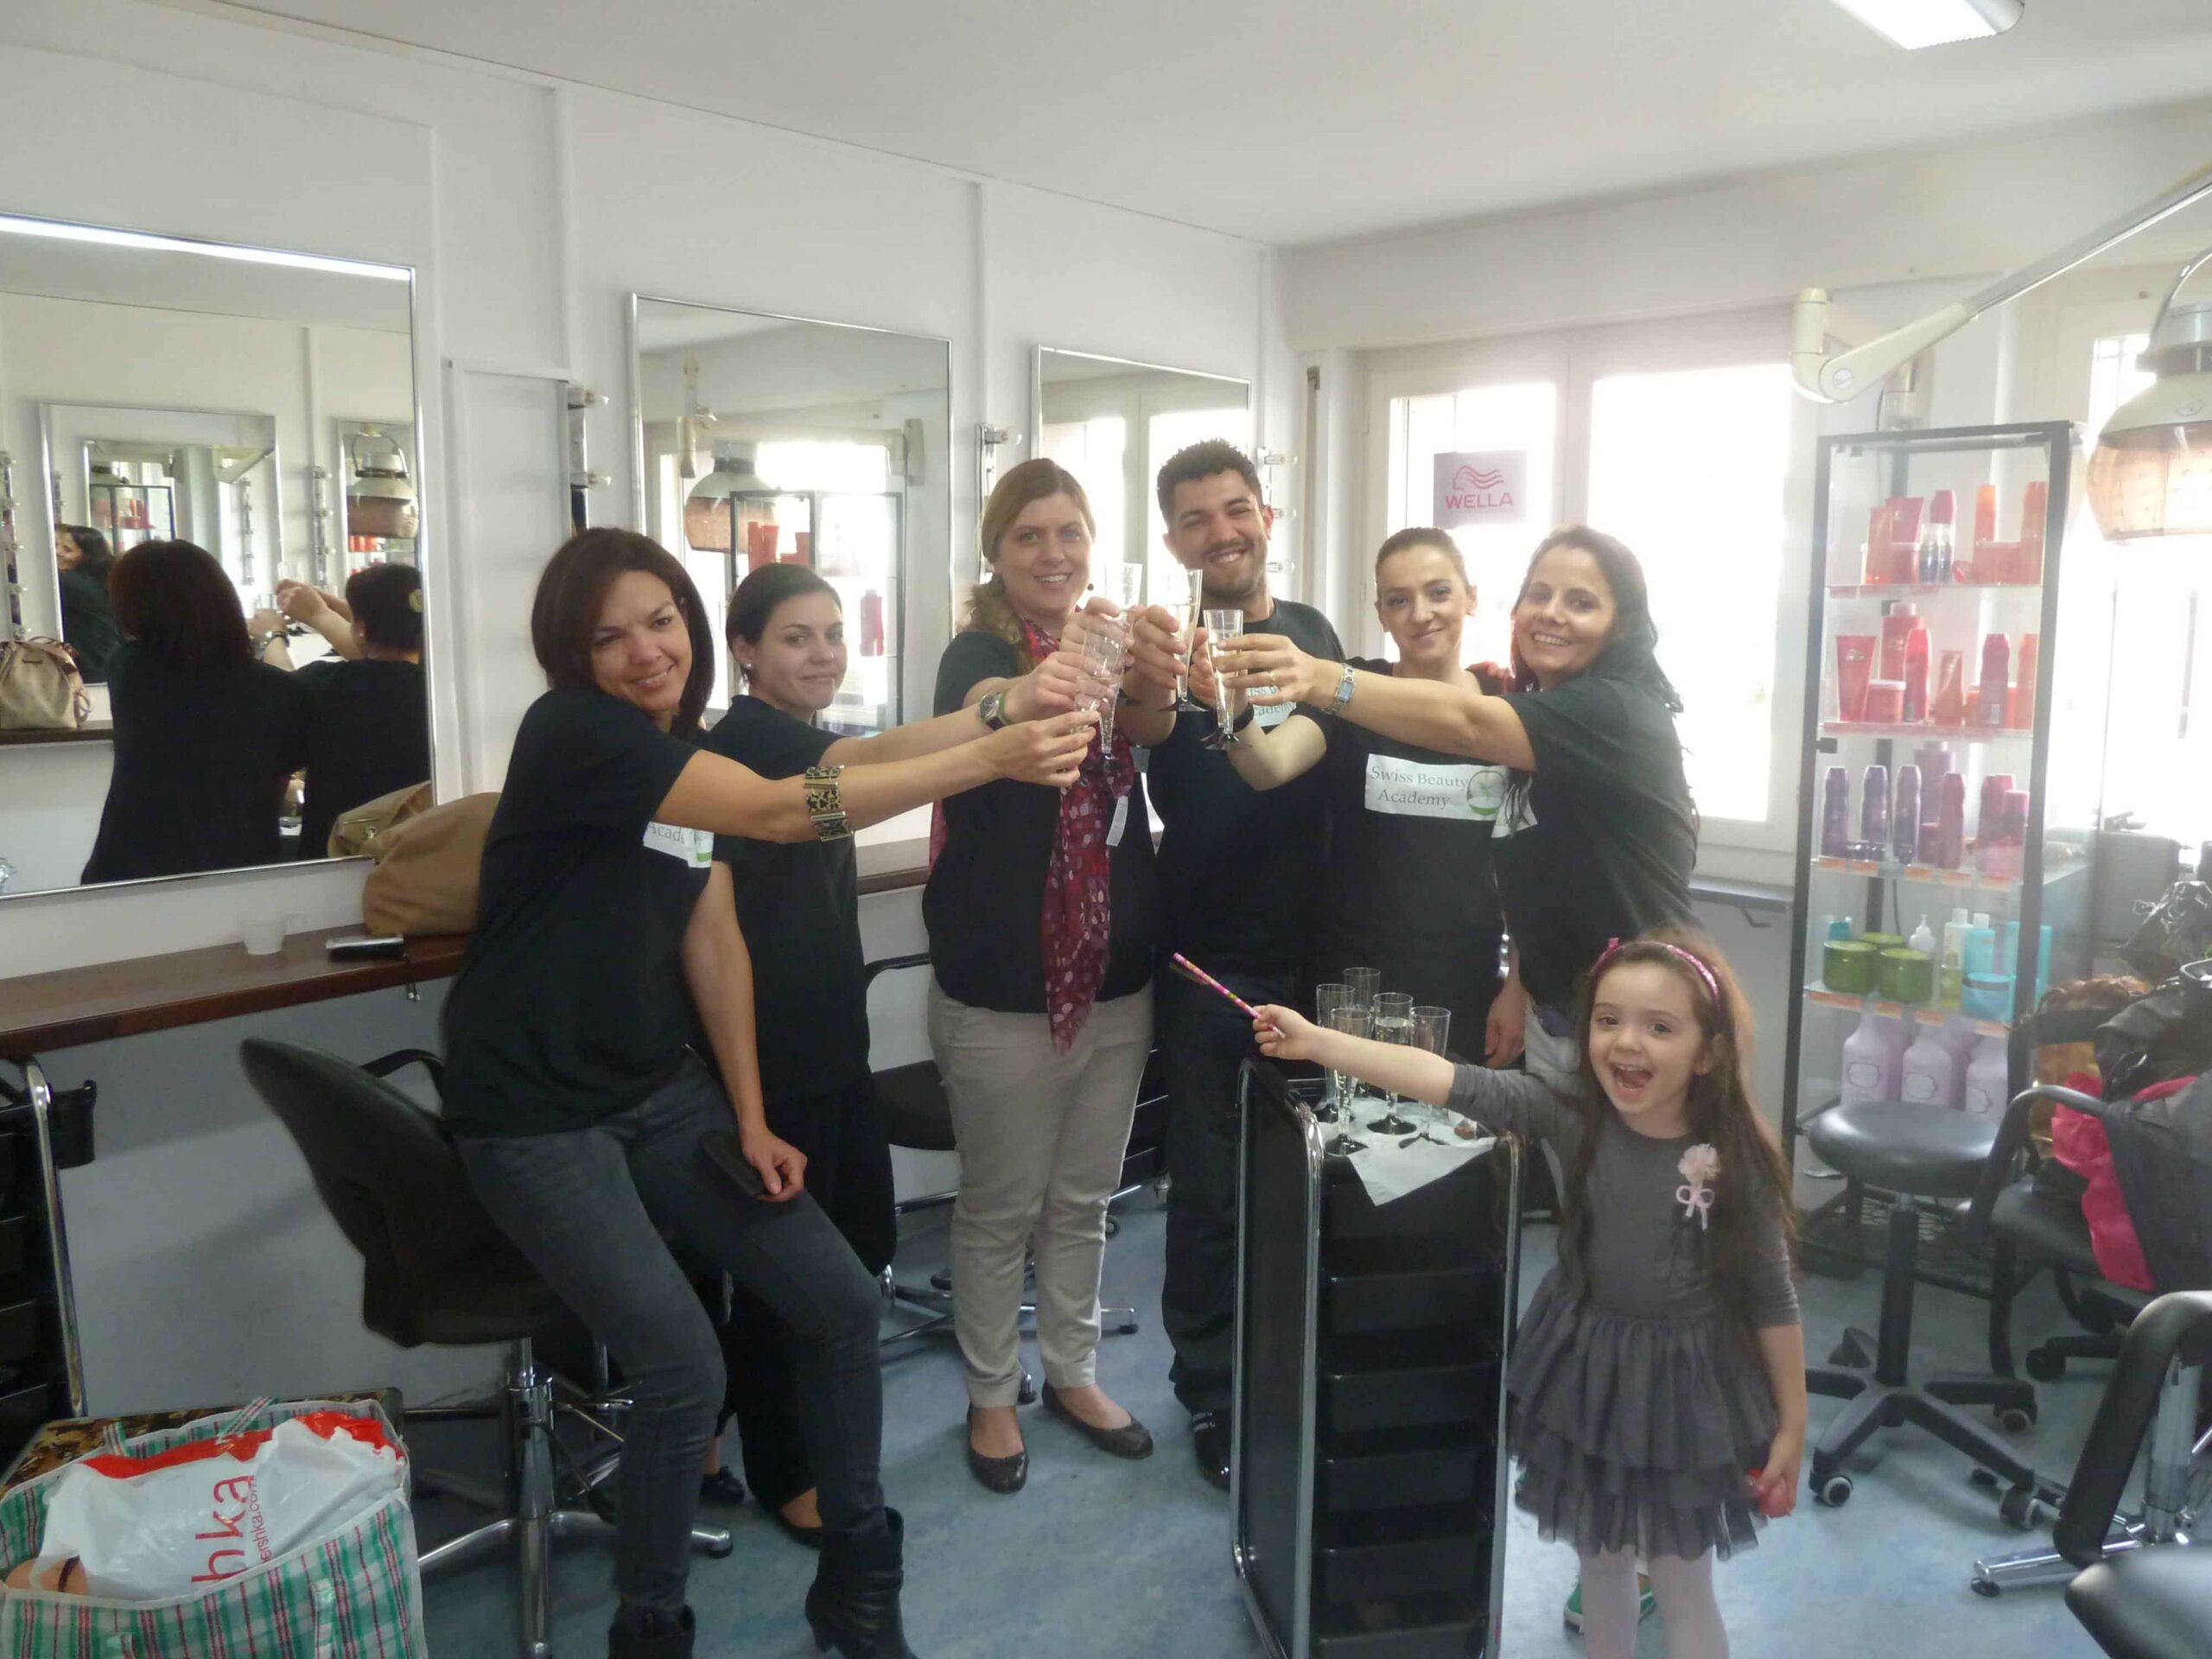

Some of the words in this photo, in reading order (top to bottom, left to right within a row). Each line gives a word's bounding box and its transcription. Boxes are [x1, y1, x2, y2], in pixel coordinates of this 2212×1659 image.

[1445, 493, 1513, 509] WELLA
[1371, 766, 1413, 783] Swiss
[1418, 773, 1468, 791] Beauty
[1378, 789, 1451, 810] Academy
